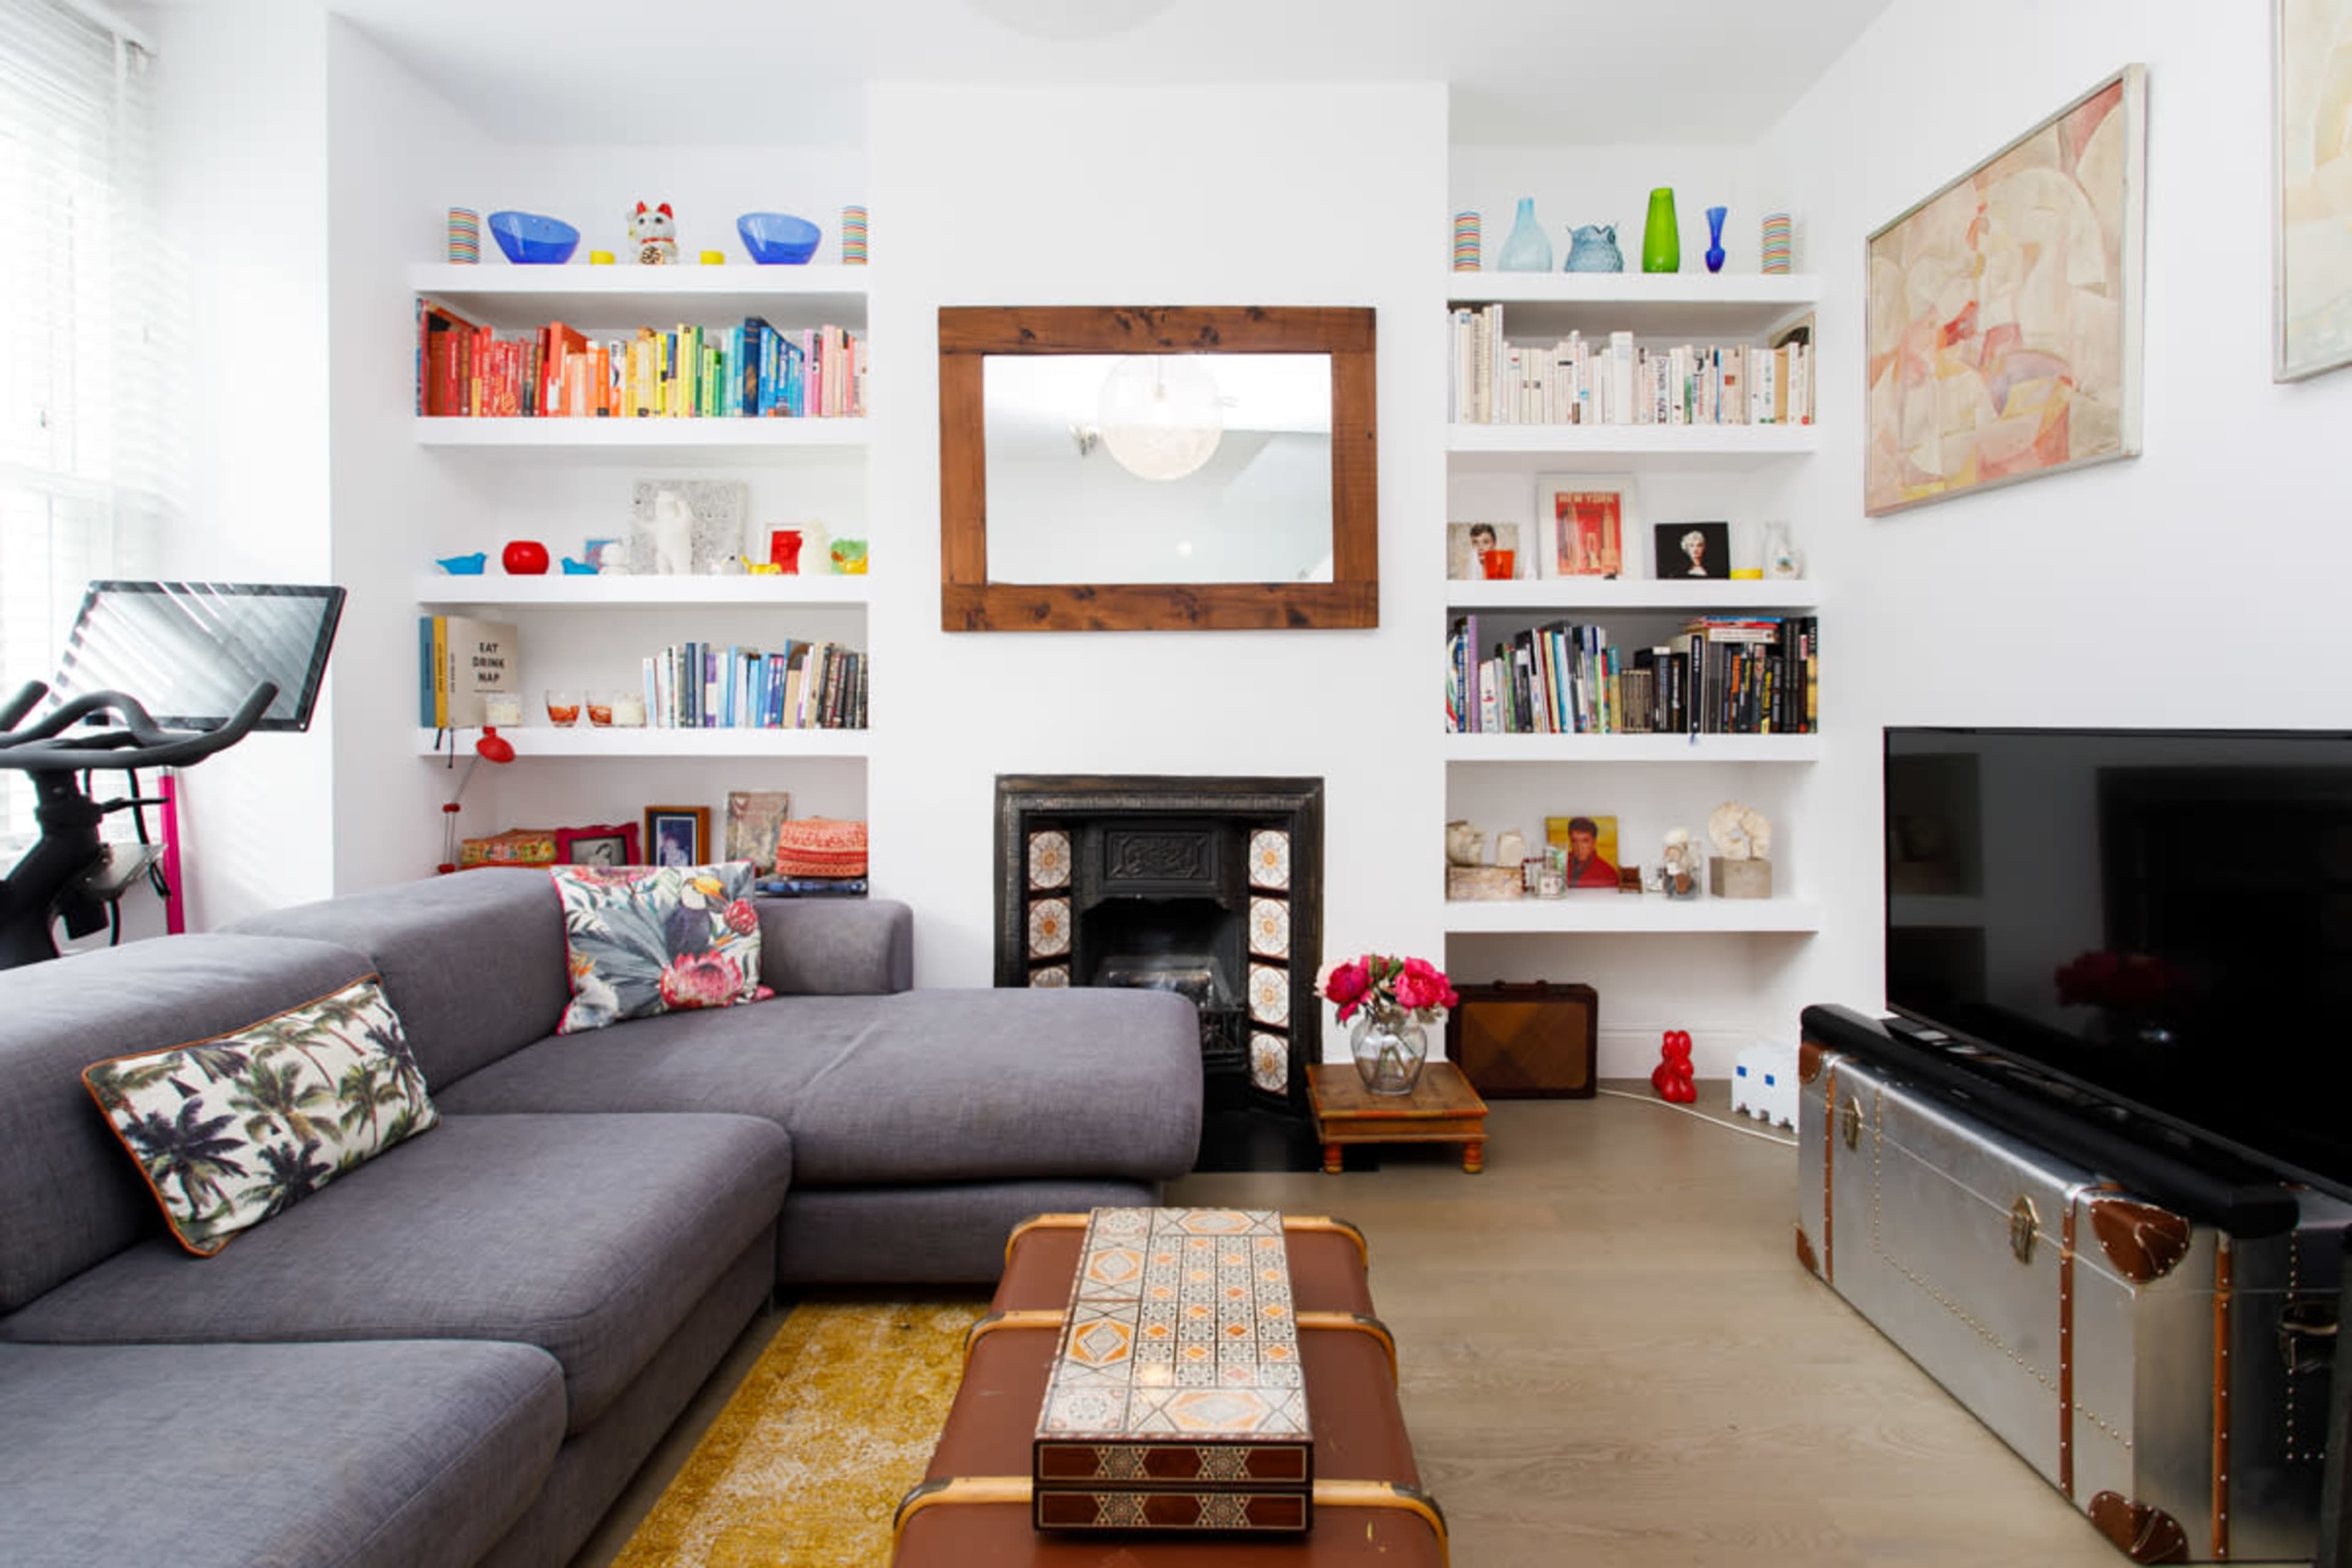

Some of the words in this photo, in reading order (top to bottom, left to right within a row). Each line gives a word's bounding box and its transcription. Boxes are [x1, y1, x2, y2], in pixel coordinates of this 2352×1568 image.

[480, 643, 499, 653] EAT
[473, 656, 505, 668] DRINK
[478, 673, 500, 682] NAP
